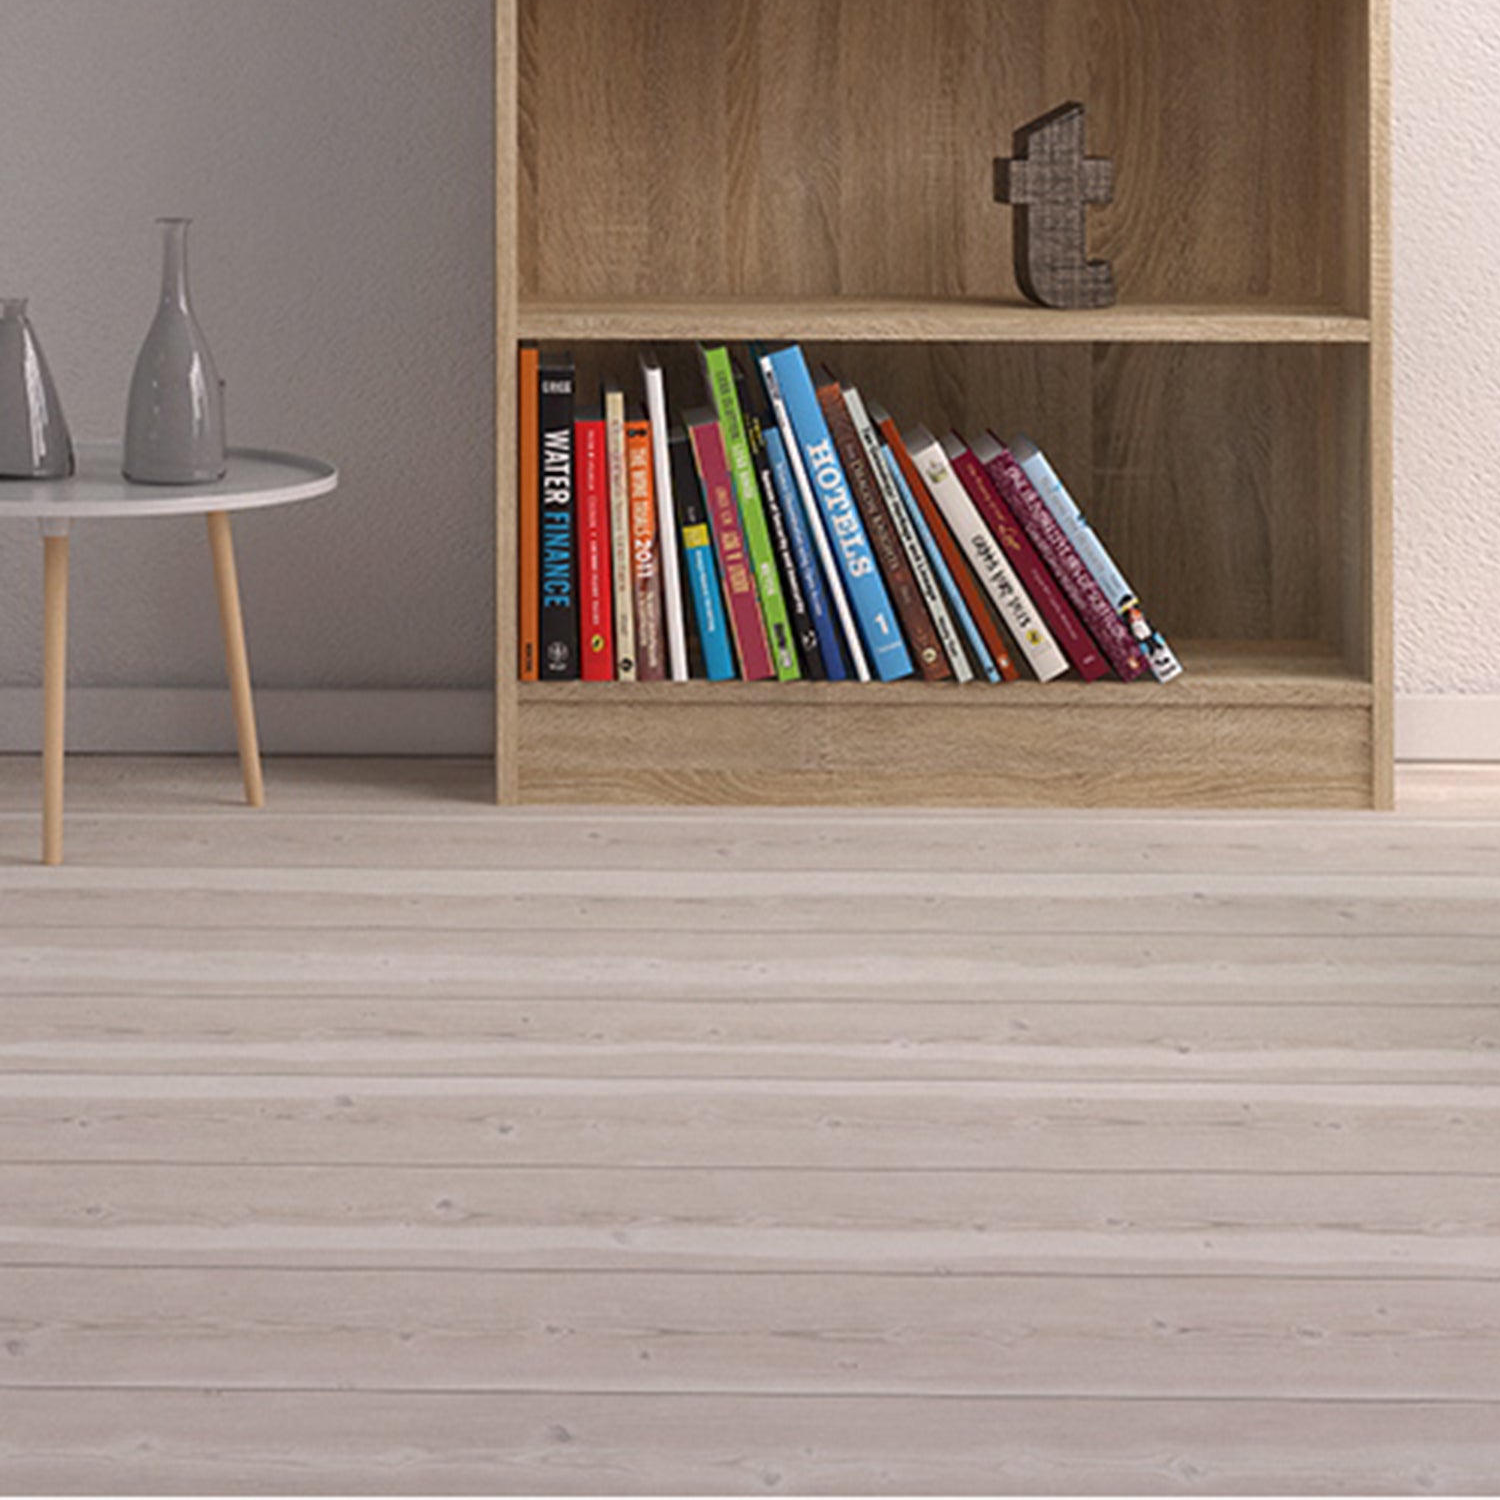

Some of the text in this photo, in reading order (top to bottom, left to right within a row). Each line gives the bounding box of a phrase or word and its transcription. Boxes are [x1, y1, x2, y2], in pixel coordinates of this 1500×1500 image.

[994, 100, 1116, 309] t
[543, 430, 572, 608] WATER FINANCE
[633, 537, 654, 579] 2011
[810, 438, 890, 635] HOTELS 1
